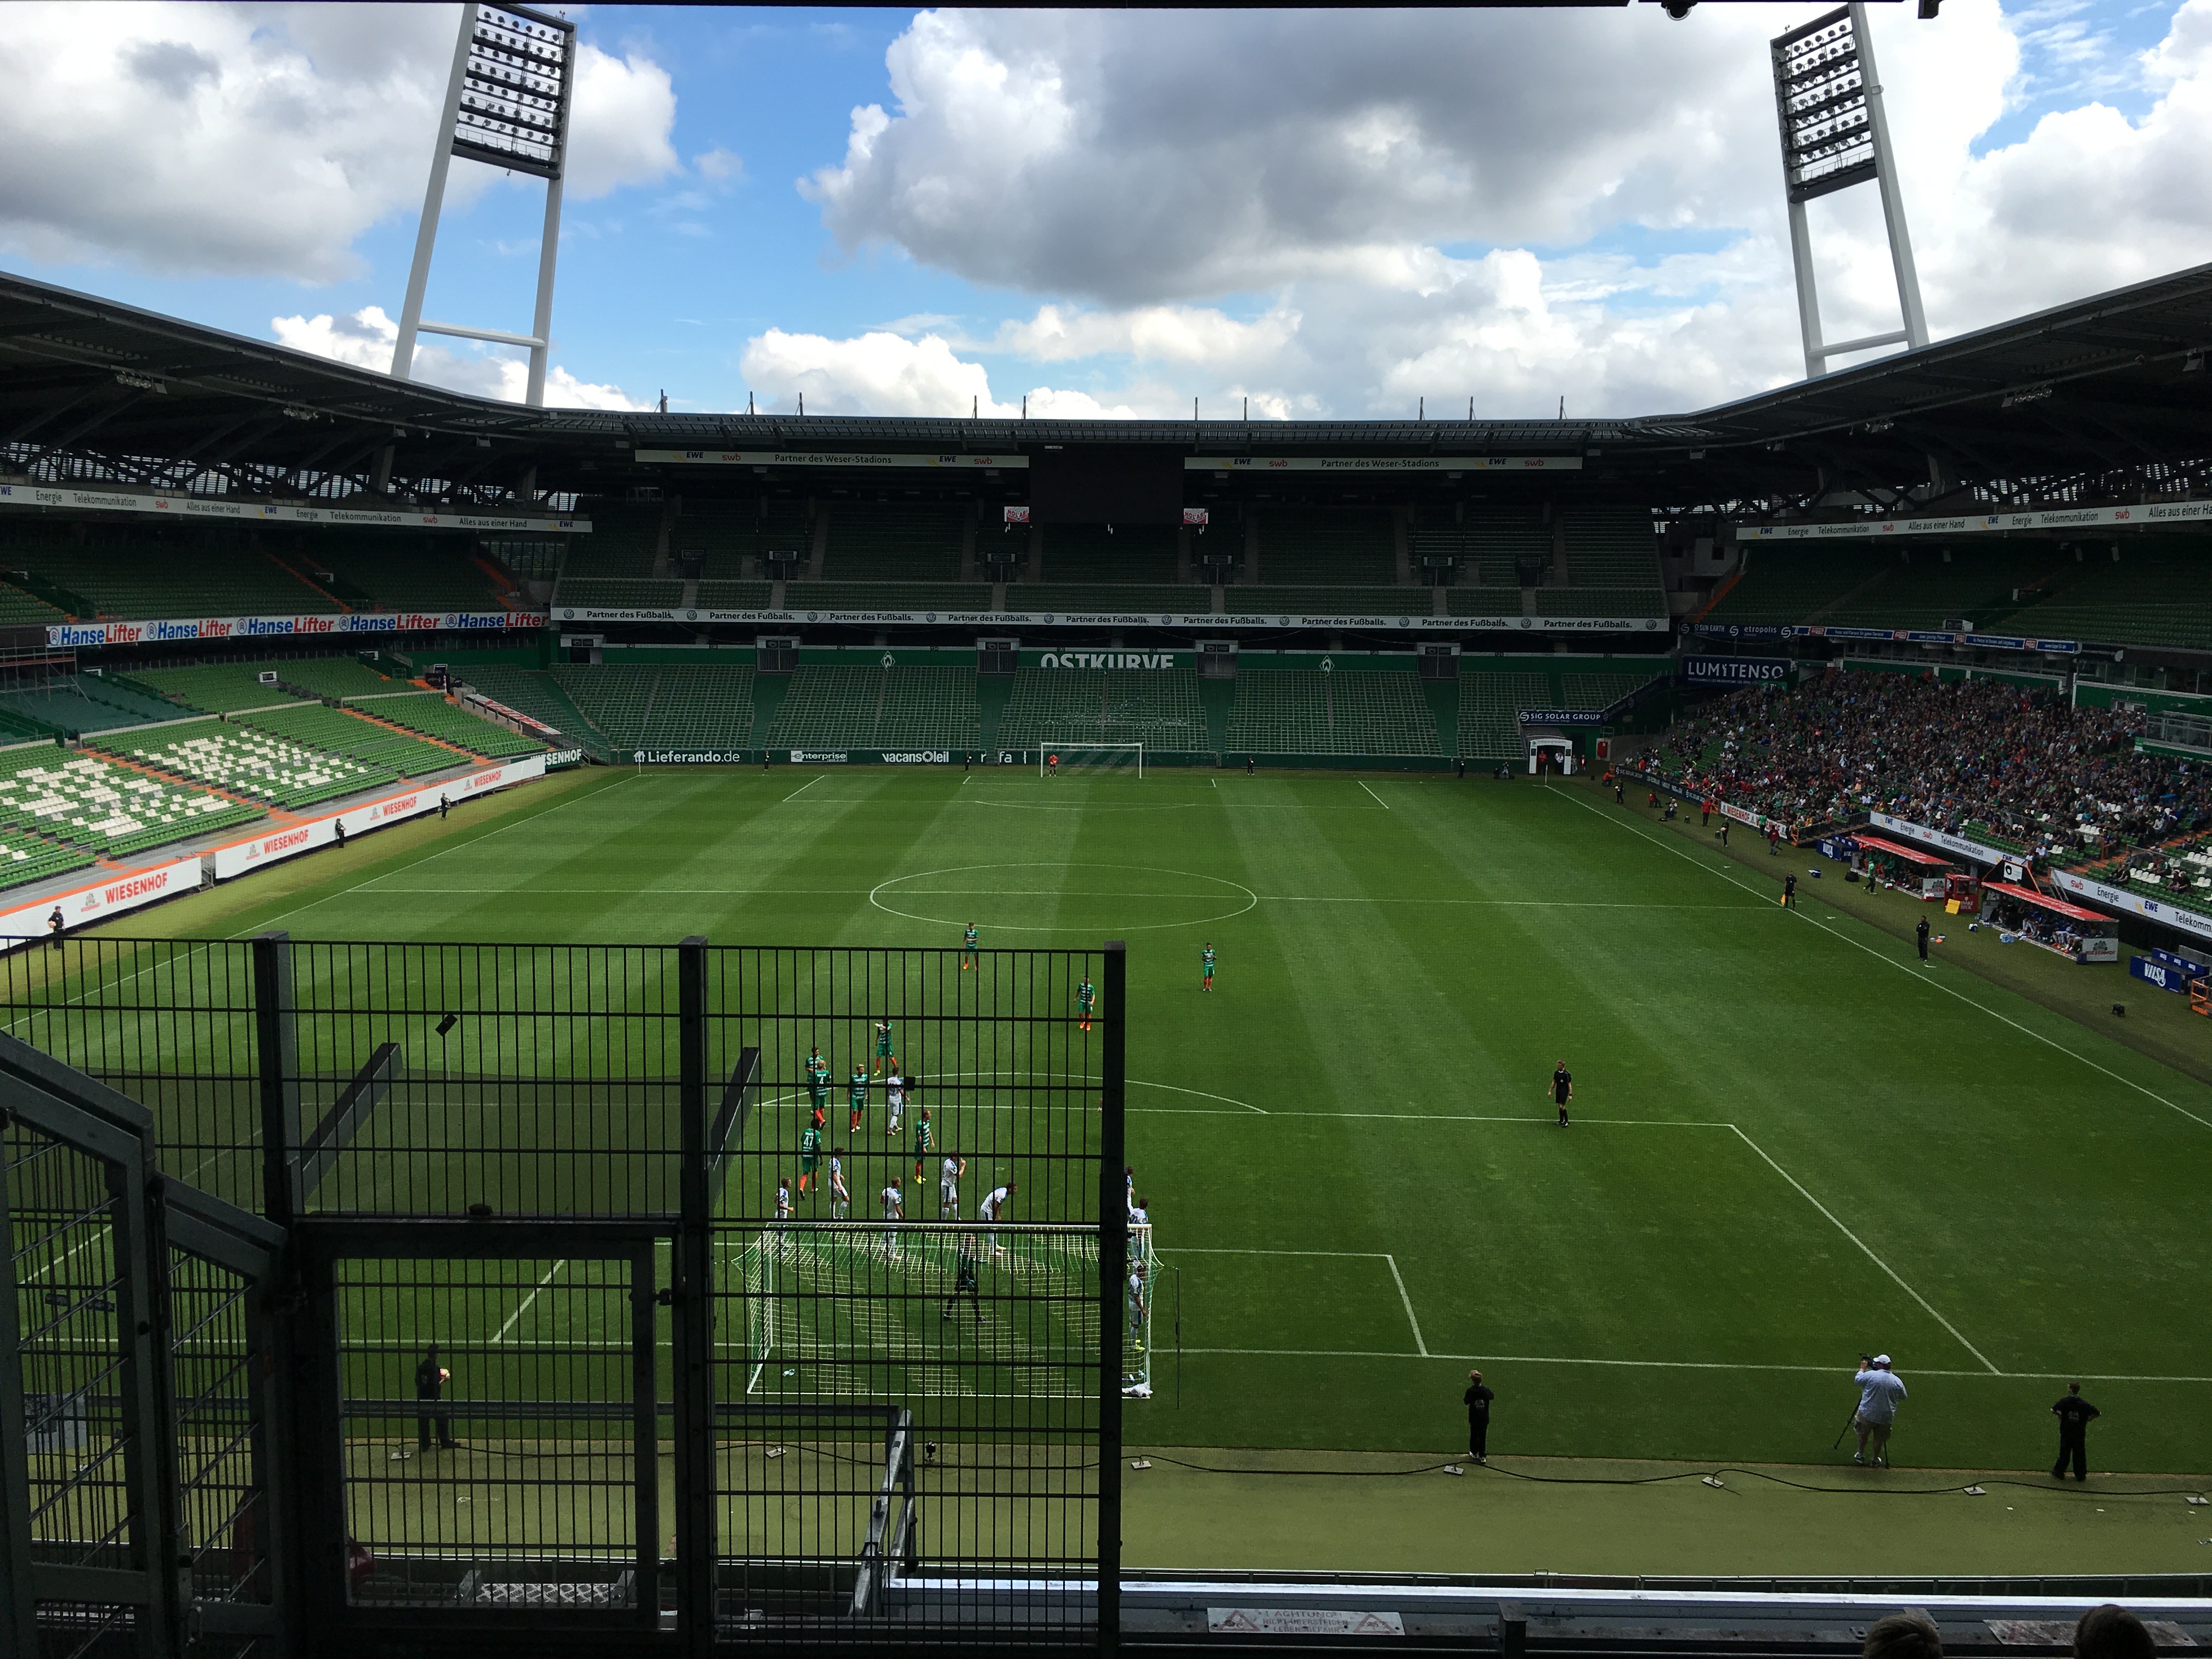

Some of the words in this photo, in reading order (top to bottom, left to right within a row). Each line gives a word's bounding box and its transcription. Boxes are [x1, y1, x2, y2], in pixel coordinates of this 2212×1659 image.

[825, 455, 891, 464] Weser-Stadions
[1, 486, 11, 495] WE
[36, 490, 61, 504] Energie
[74, 493, 137, 507] Telekommunikation
[155, 500, 168, 509] swb
[187, 502, 200, 511] Alles
[212, 504, 224, 513] einer
[226, 505, 240, 514] Hand
[265, 506, 277, 515] EWE
[296, 510, 318, 521] Energie
[330, 512, 401, 522] Telekommunikation
[1788, 528, 1809, 537] Energie
[1818, 525, 1869, 534] Telekommunikation
[1883, 523, 1894, 531] swb
[1909, 521, 1921, 530] Alles
[1949, 519, 1965, 528] Hand
[1988, 516, 1999, 524] EWE
[2012, 515, 2032, 527] Energie
[2041, 511, 2098, 523] Telekommunikation
[2115, 508, 2130, 520] swb
[2149, 505, 2166, 517] Alles
[2168, 507, 2180, 516] aus
[2182, 505, 2200, 516] einer
[2203, 504, 2212, 515] Ha
[157, 619, 232, 639] HanseLifter
[247, 616, 335, 634] HanseLifter
[349, 614, 440, 630] HanseLifter
[458, 613, 549, 628] HanseLifter
[61, 624, 142, 645] HanseLifter
[1041, 653, 1174, 668] OSTKURVE
[648, 751, 740, 762] Lieferando.de
[794, 753, 847, 761] enterprise
[474, 770, 501, 787] WIESENHOF
[382, 796, 417, 816] WIESENHOF
[263, 829, 309, 854] WIESENHOF
[1900, 823, 1915, 835] Energie
[1941, 833, 1984, 856] Telekommunikation
[105, 872, 167, 904] WIESENHOF
[2071, 879, 2083, 890] swb
[2097, 887, 2119, 904] Energie
[2145, 900, 2158, 912] EWE
[2175, 911, 2212, 933] Telekomm
[2145, 963, 2166, 986] VILSA
